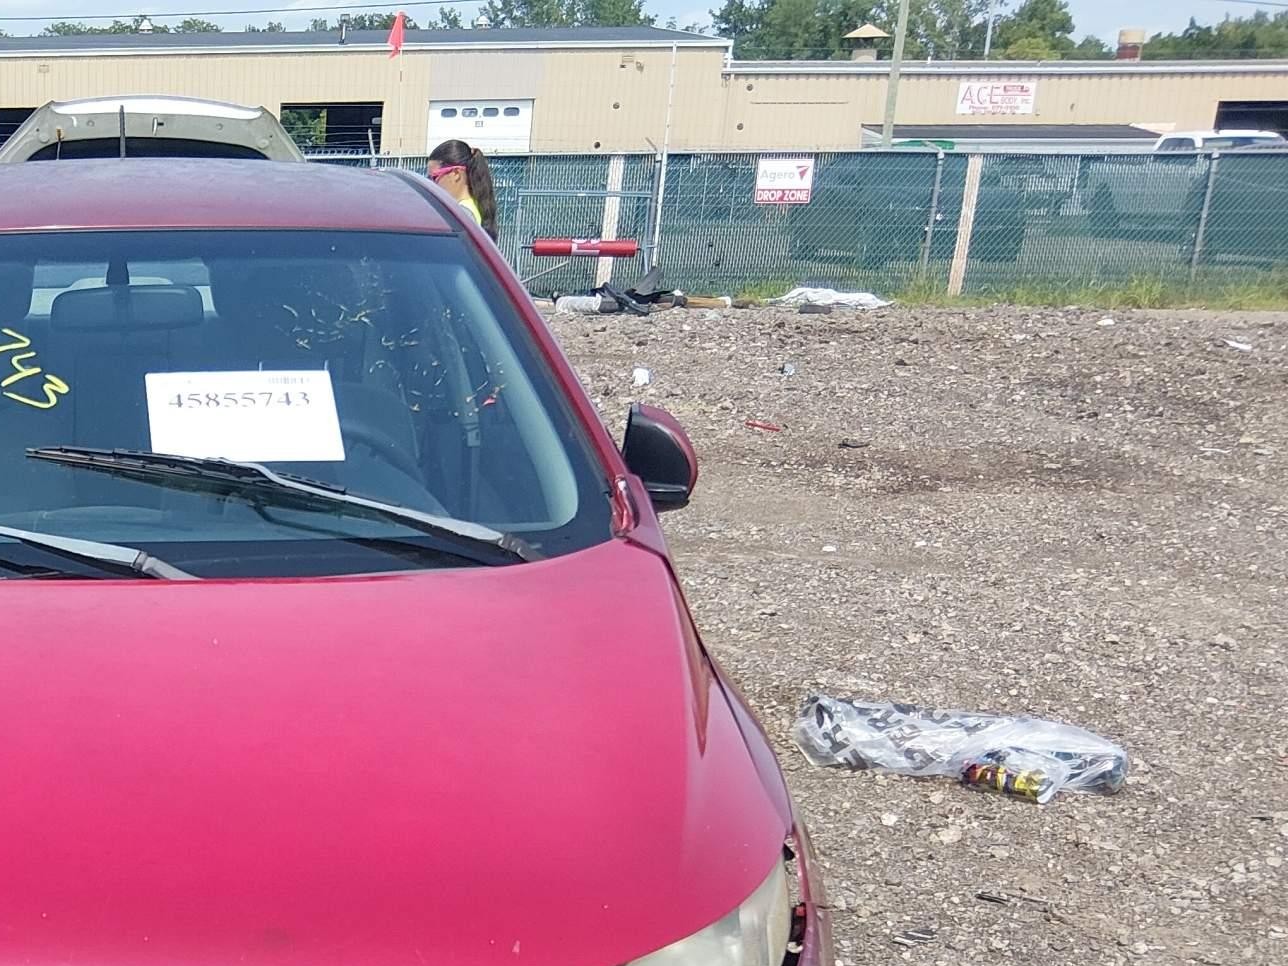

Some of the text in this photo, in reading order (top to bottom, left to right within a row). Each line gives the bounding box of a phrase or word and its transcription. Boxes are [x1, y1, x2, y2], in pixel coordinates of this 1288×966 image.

[960, 86, 1001, 104] ACE
[760, 169, 795, 182] Agero
[757, 190, 809, 201] DROP ZONE
[168, 391, 311, 408] 45855743
